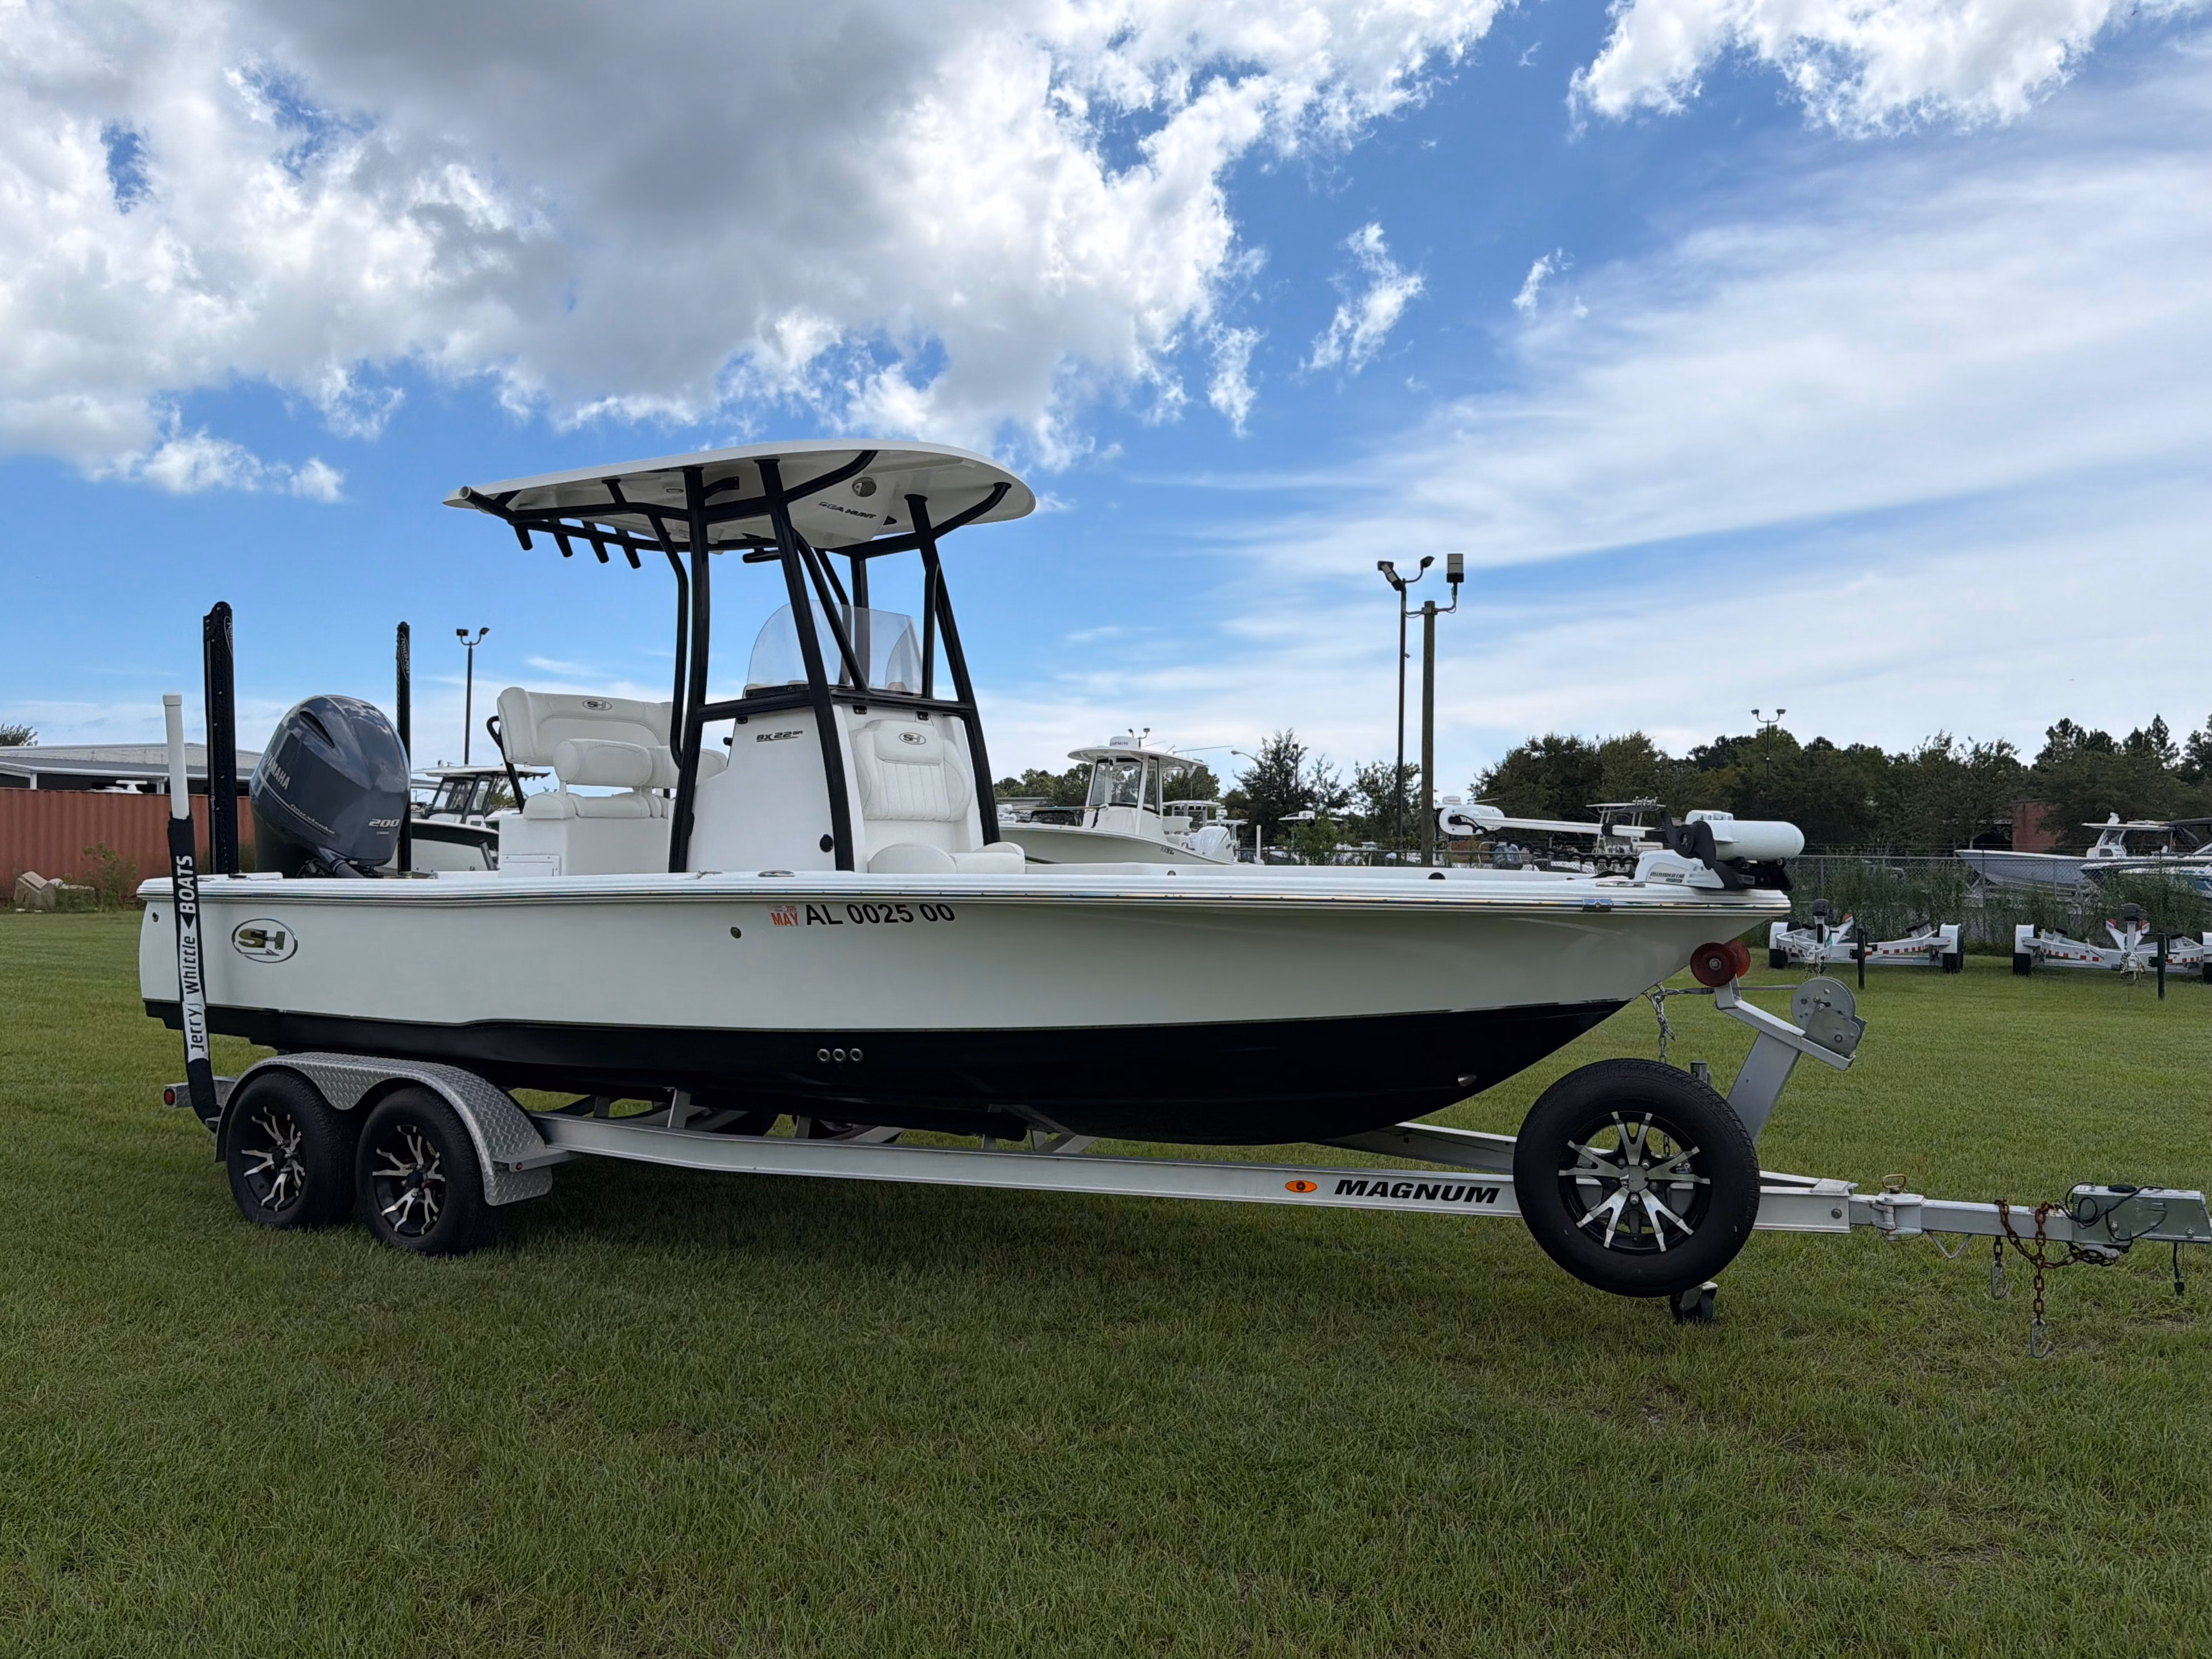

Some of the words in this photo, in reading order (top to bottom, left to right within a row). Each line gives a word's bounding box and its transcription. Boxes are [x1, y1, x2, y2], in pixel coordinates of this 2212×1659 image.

[265, 752, 290, 790] YAMAHA
[369, 819, 400, 827] 200
[176, 855, 196, 915] BOATS
[771, 912, 798, 926] MAY
[806, 904, 843, 925] AL
[846, 904, 914, 924] 0025
[919, 904, 955, 922] 00
[182, 935, 200, 994] Whittle
[187, 1008, 204, 1052] Jerry
[1334, 1179, 1500, 1203] MAGNUM
